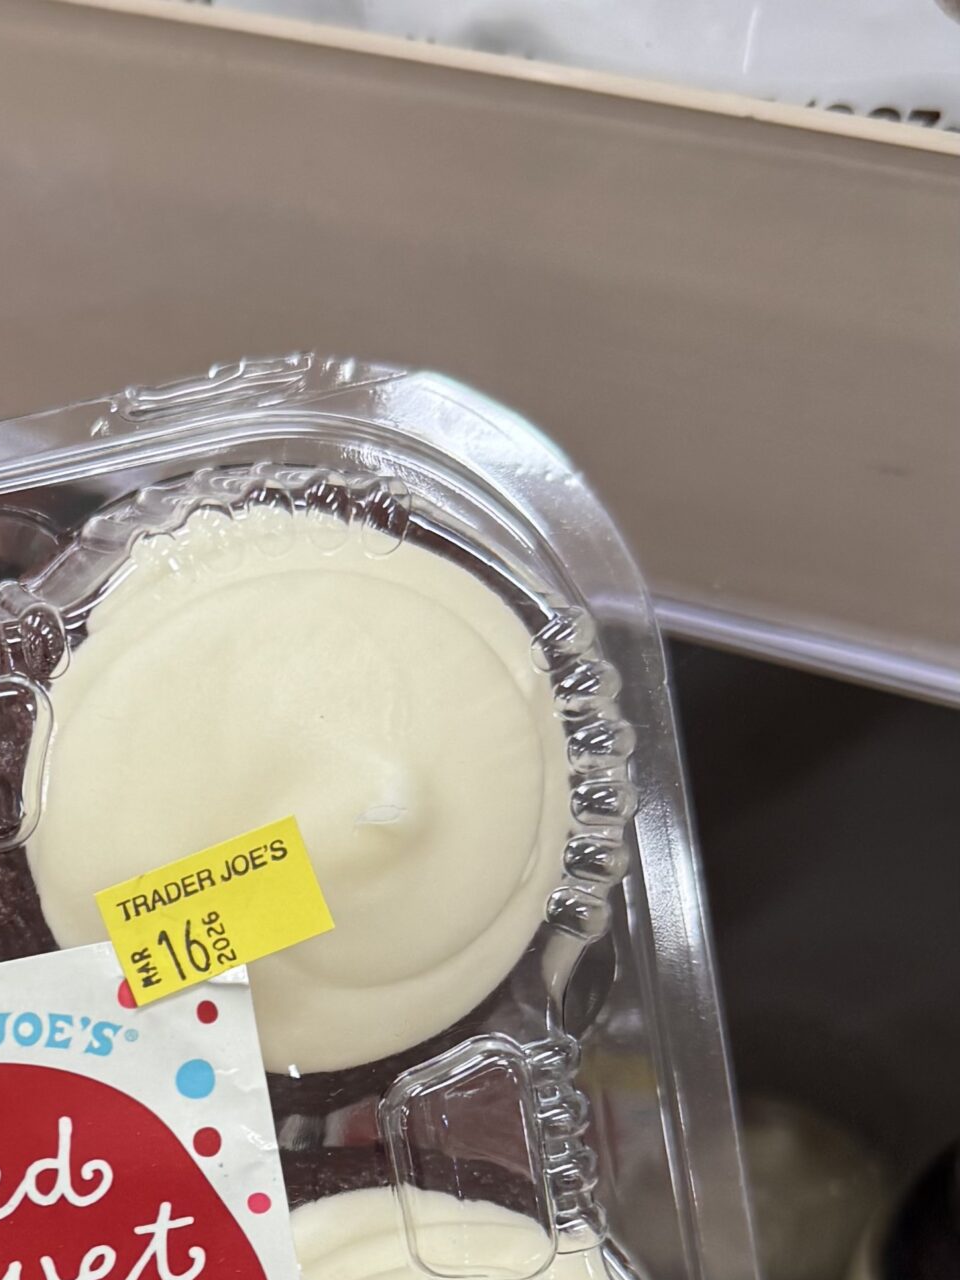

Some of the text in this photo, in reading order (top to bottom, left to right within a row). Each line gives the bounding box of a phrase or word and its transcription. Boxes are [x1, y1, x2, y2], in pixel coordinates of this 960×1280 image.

[116, 839, 288, 921] TRADER JOE'S
[157, 919, 211, 981] 16
[202, 911, 237, 965] 2026
